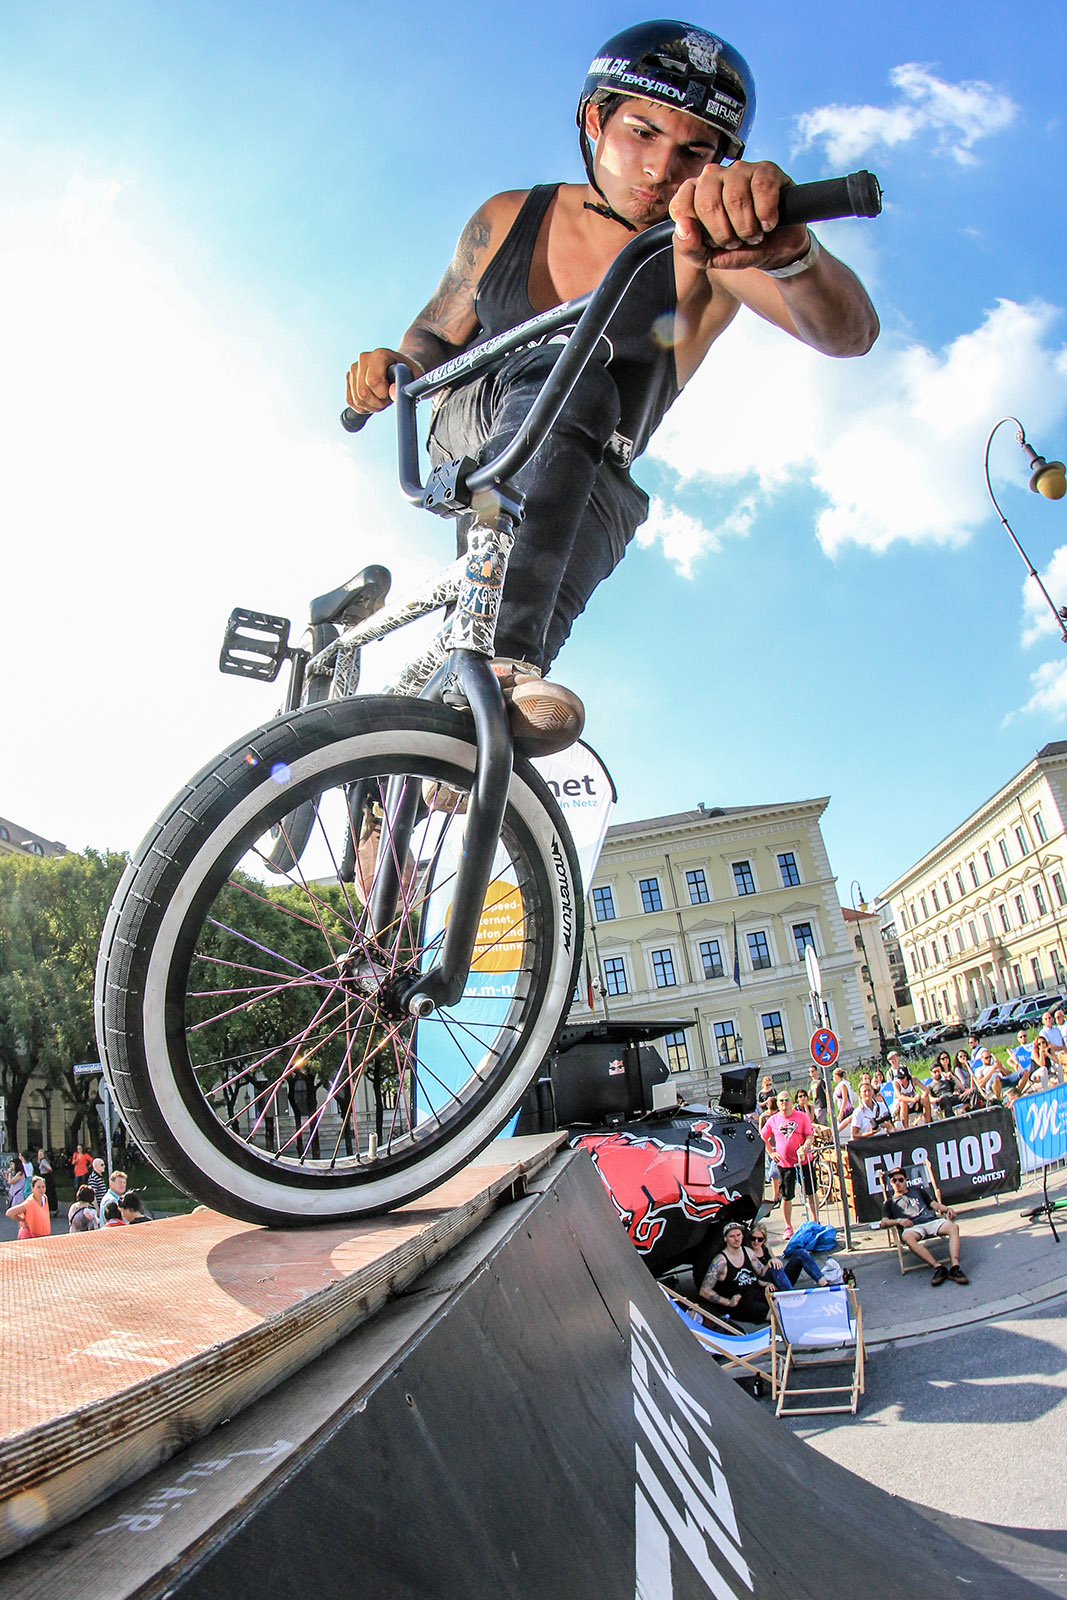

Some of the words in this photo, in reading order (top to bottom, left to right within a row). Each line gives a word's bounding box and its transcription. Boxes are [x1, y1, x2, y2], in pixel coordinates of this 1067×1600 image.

[621, 73, 687, 101] DEMOLITION
[717, 105, 741, 124] FUSE
[573, 799, 598, 809] Netz
[552, 840, 574, 950] momentum
[936, 1130, 1003, 1181] HOP
[972, 1169, 1006, 1185] CONTEST
